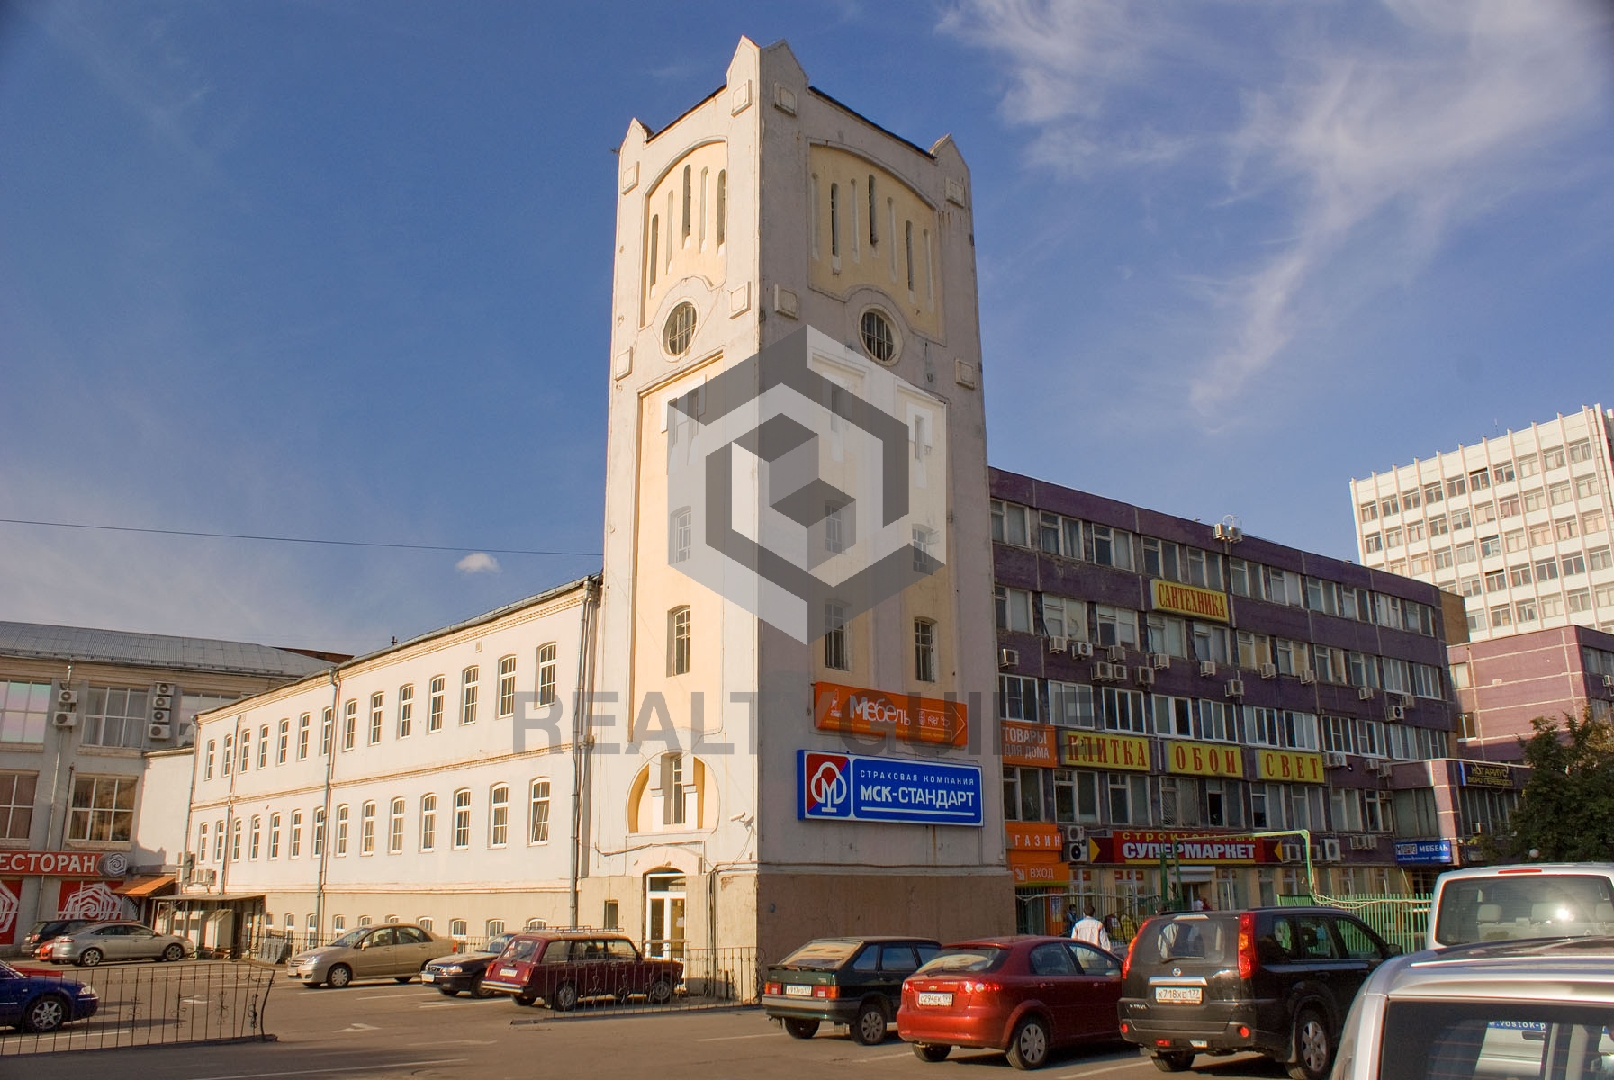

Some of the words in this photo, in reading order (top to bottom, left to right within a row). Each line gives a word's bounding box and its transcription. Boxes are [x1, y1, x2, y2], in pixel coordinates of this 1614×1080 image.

[1158, 583, 1226, 618] САНТЕХНИКА
[850, 695, 912, 726] Мебель
[1003, 727, 1047, 744] ТОВАРЫ
[1005, 744, 1023, 757] ДЛЯ
[1025, 746, 1050, 760] ДОМА
[1067, 734, 1147, 767] ПЛИТКА
[1175, 745, 1237, 774] ОБОИ
[1265, 753, 1318, 780] СВЕТ
[860, 769, 918, 782] СТРАХОВАЯ
[923, 775, 975, 786] КОМПАНИЯ
[860, 784, 975, 809] МСК-СТАНДАРТ
[1014, 834, 1061, 847] ГАЗИН
[1419, 844, 1449, 853] МЕБЕЛЬ
[1122, 841, 1257, 859] СУПЕРМАРКЕТ
[1030, 867, 1054, 879] ВХОД
